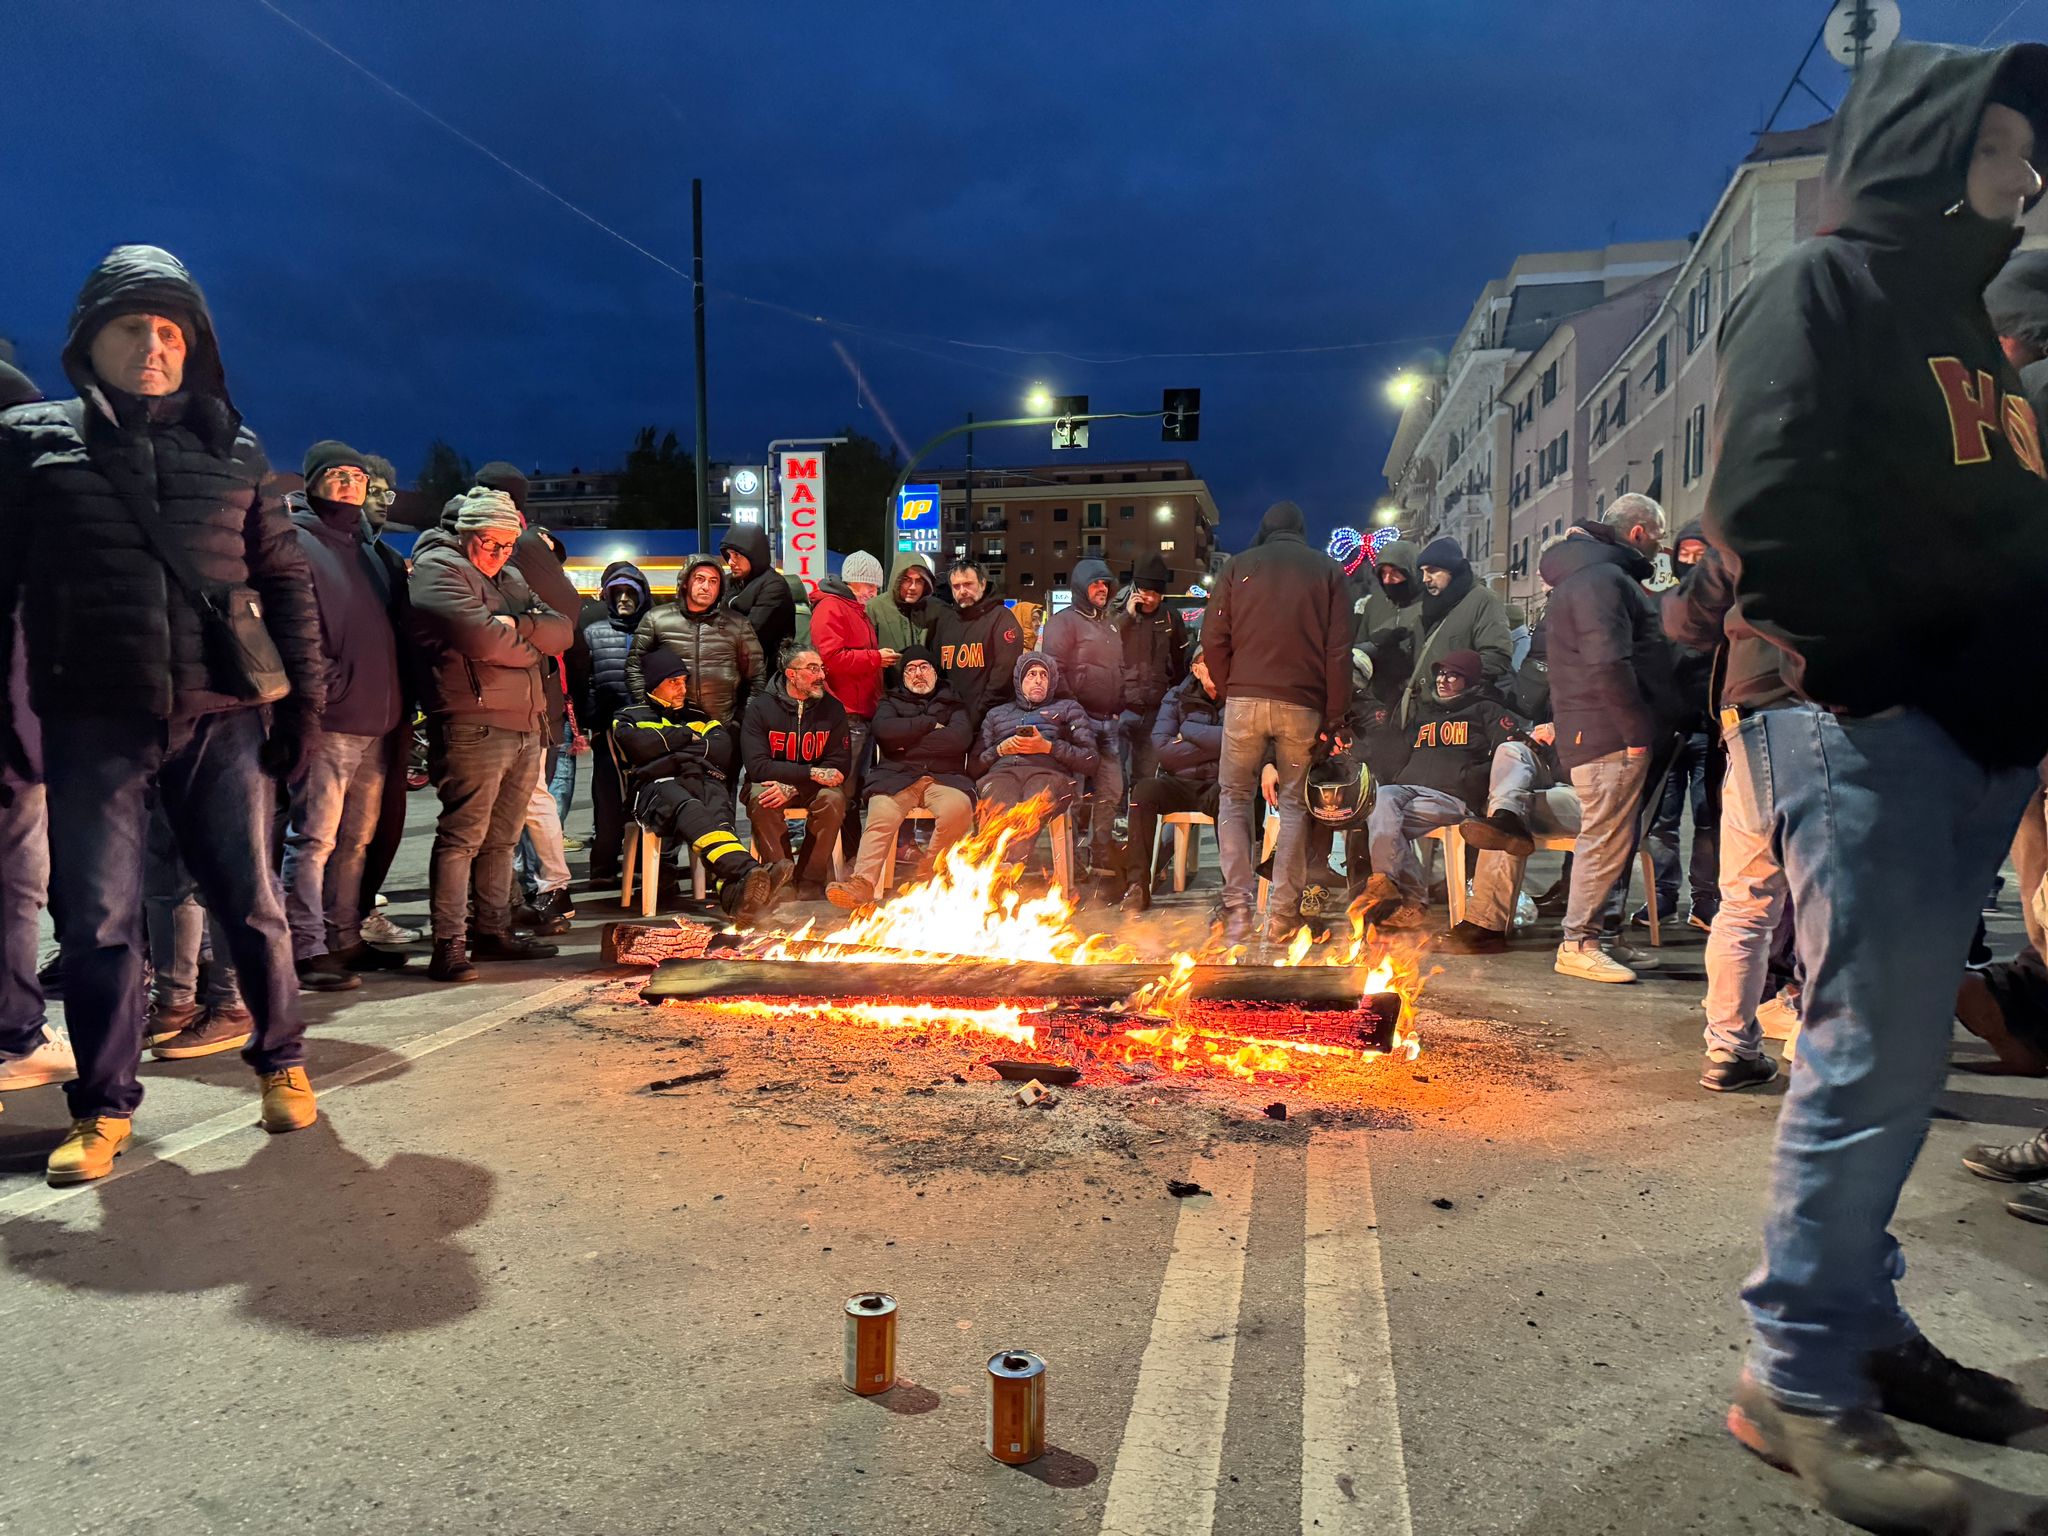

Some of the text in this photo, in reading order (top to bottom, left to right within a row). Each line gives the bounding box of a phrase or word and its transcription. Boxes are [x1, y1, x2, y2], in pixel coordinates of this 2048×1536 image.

[735, 507, 758, 523] FIAT
[901, 499, 933, 520] IP
[941, 642, 985, 670] FIOM
[1414, 721, 1468, 748] FIOM
